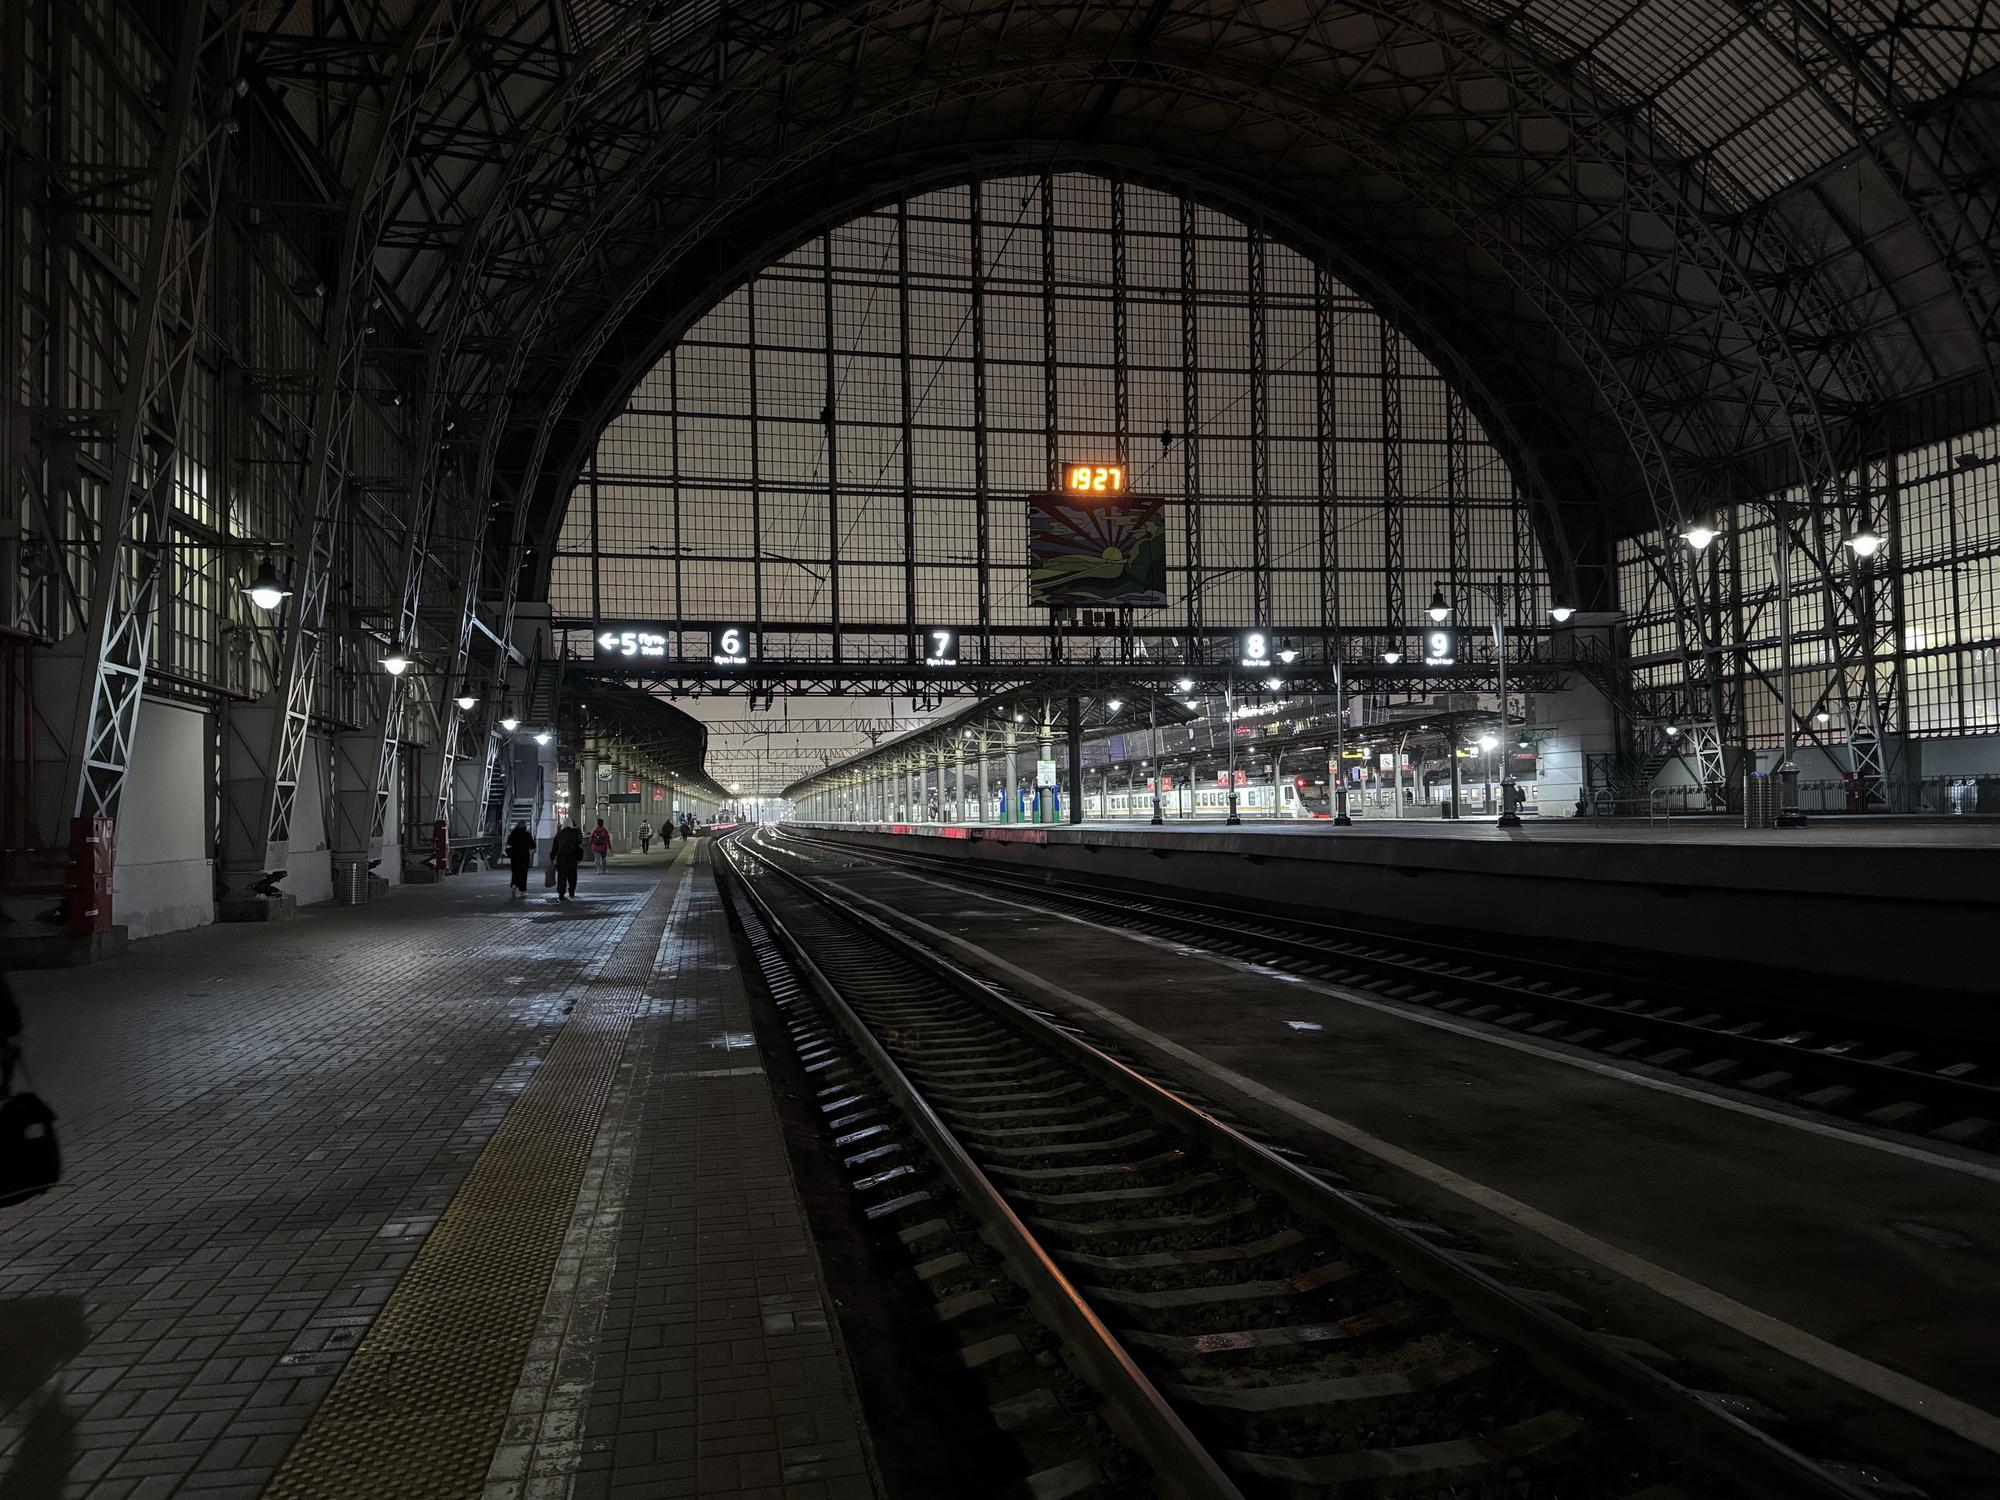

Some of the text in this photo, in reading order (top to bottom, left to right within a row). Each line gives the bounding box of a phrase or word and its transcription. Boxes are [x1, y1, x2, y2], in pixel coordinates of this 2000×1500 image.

[621, 633, 637, 655] 5
[722, 629, 740, 654] 6
[933, 633, 949, 656] 7
[1248, 634, 1265, 658] 8
[1431, 633, 1447, 656] 9
